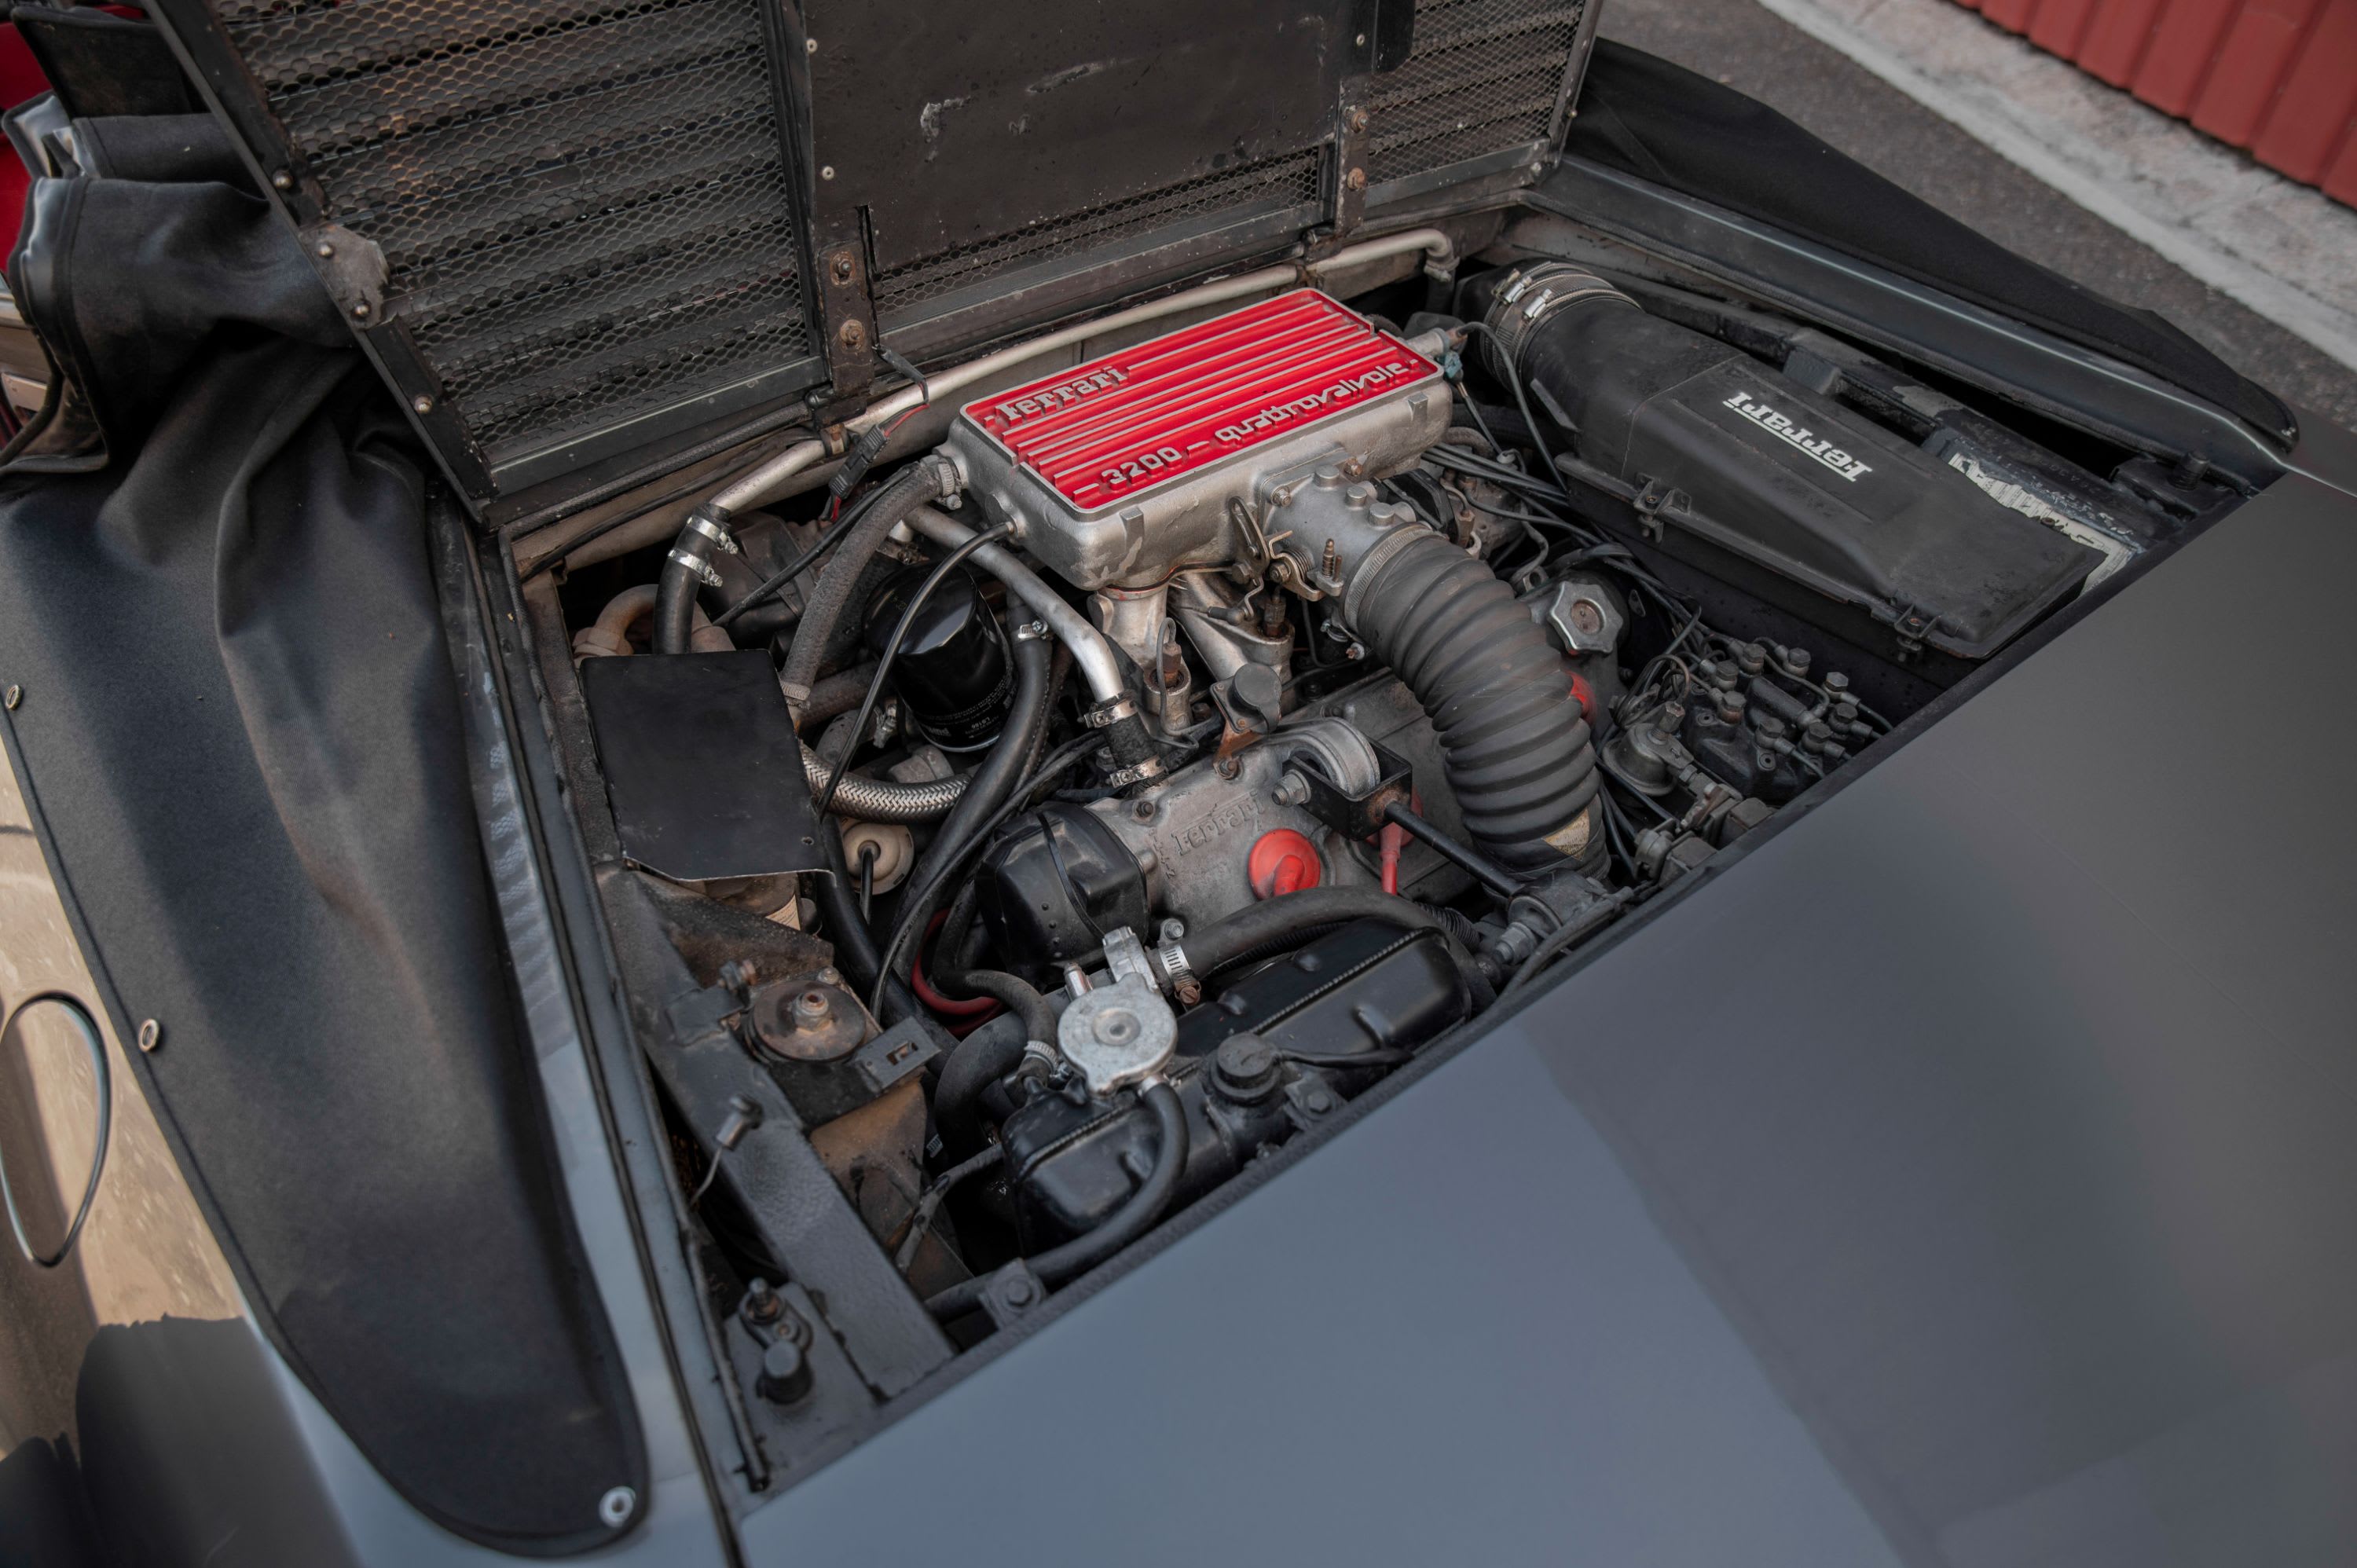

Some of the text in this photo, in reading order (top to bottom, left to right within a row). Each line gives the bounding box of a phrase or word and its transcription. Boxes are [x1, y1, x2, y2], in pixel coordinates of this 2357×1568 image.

[994, 365, 1127, 422] Ferrari
[1101, 361, 1409, 486] 3200 quattrovalvole
[1722, 392, 1873, 482] Ferrari
[1171, 789, 1266, 856] Ferrari
